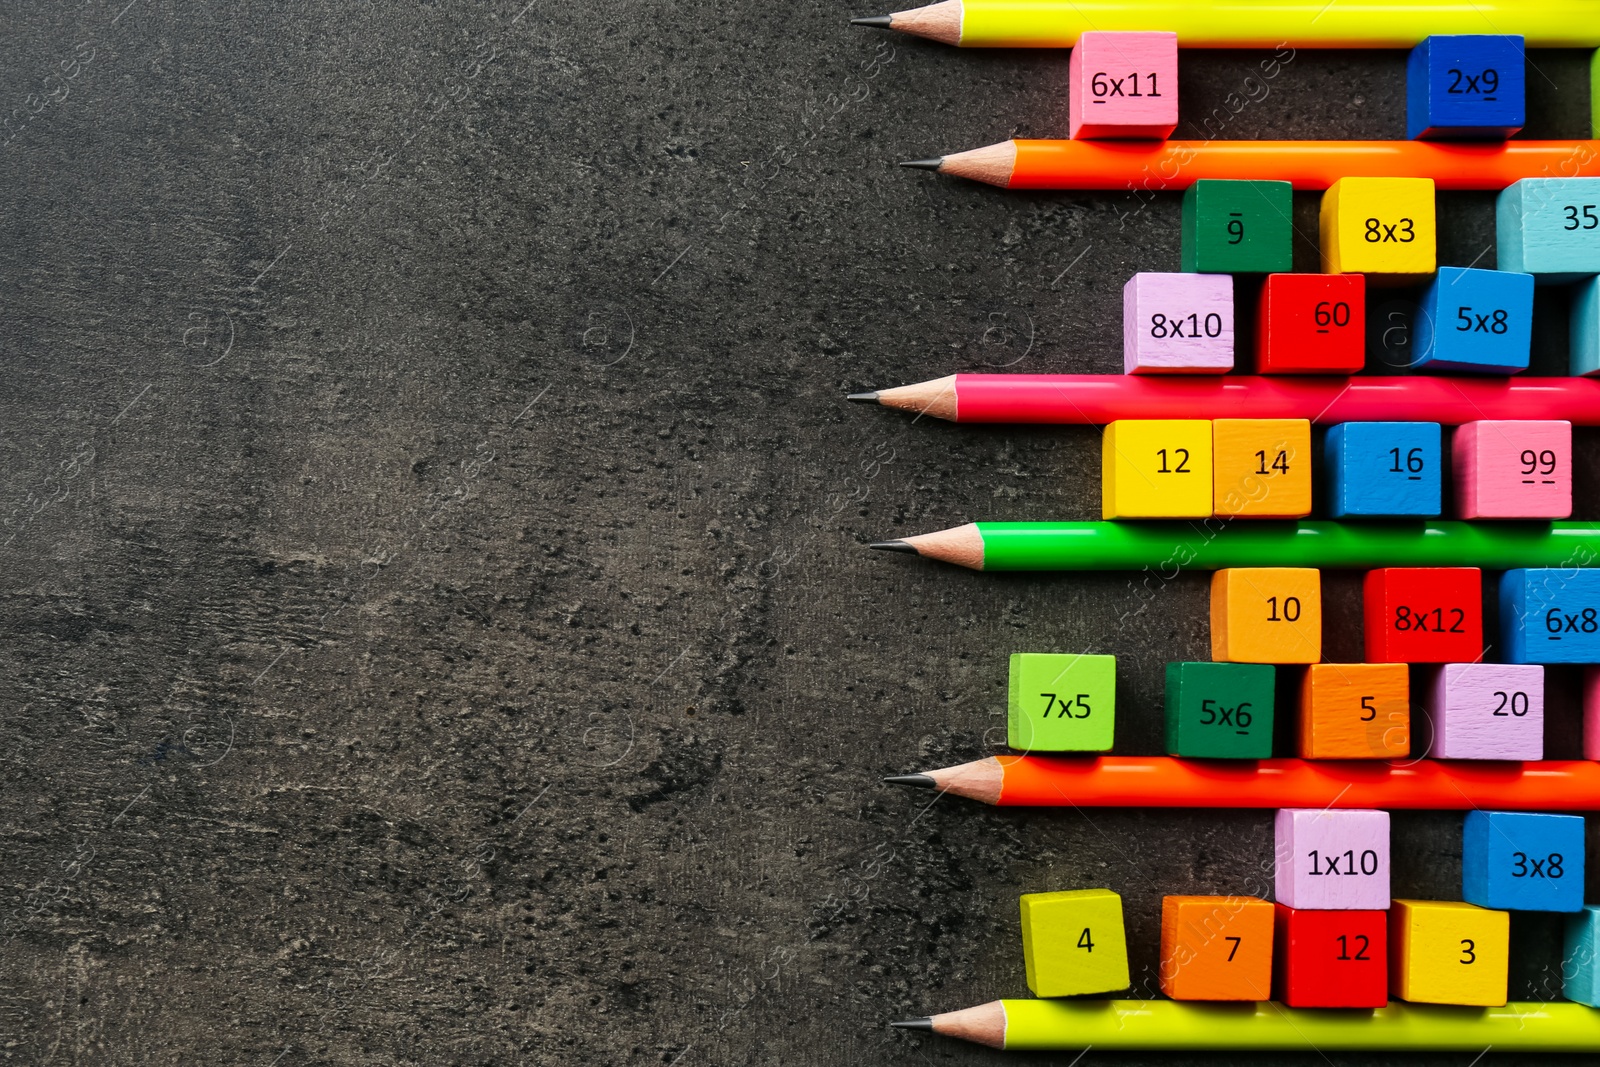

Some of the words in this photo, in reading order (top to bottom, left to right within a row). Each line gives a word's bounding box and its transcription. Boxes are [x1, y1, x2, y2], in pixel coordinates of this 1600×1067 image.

[1092, 72, 1161, 103] 6x11
[1448, 69, 1498, 101] 2x9
[1365, 218, 1415, 242] 8x3
[1564, 205, 1598, 230] 35
[1151, 313, 1222, 338] 8x10
[1315, 302, 1350, 333] 60
[1457, 307, 1508, 334] 5x8
[1157, 449, 1190, 473] 12
[1256, 450, 1289, 474] 14
[1390, 448, 1423, 480] 16
[1521, 450, 1556, 484] 99
[1267, 597, 1300, 621] 10
[1395, 606, 1464, 633] 8x12
[1546, 608, 1598, 640] 6x8
[1040, 694, 1091, 719] 7x5
[1361, 696, 1376, 721] 5
[1493, 692, 1528, 716] 20
[1200, 700, 1252, 735] 5x6
[1308, 850, 1378, 875] 1x10
[1512, 852, 1563, 878] 3x8
[1077, 928, 1094, 952] 4
[1225, 937, 1241, 961] 7
[1337, 935, 1370, 960] 12
[1460, 939, 1475, 964] 3
